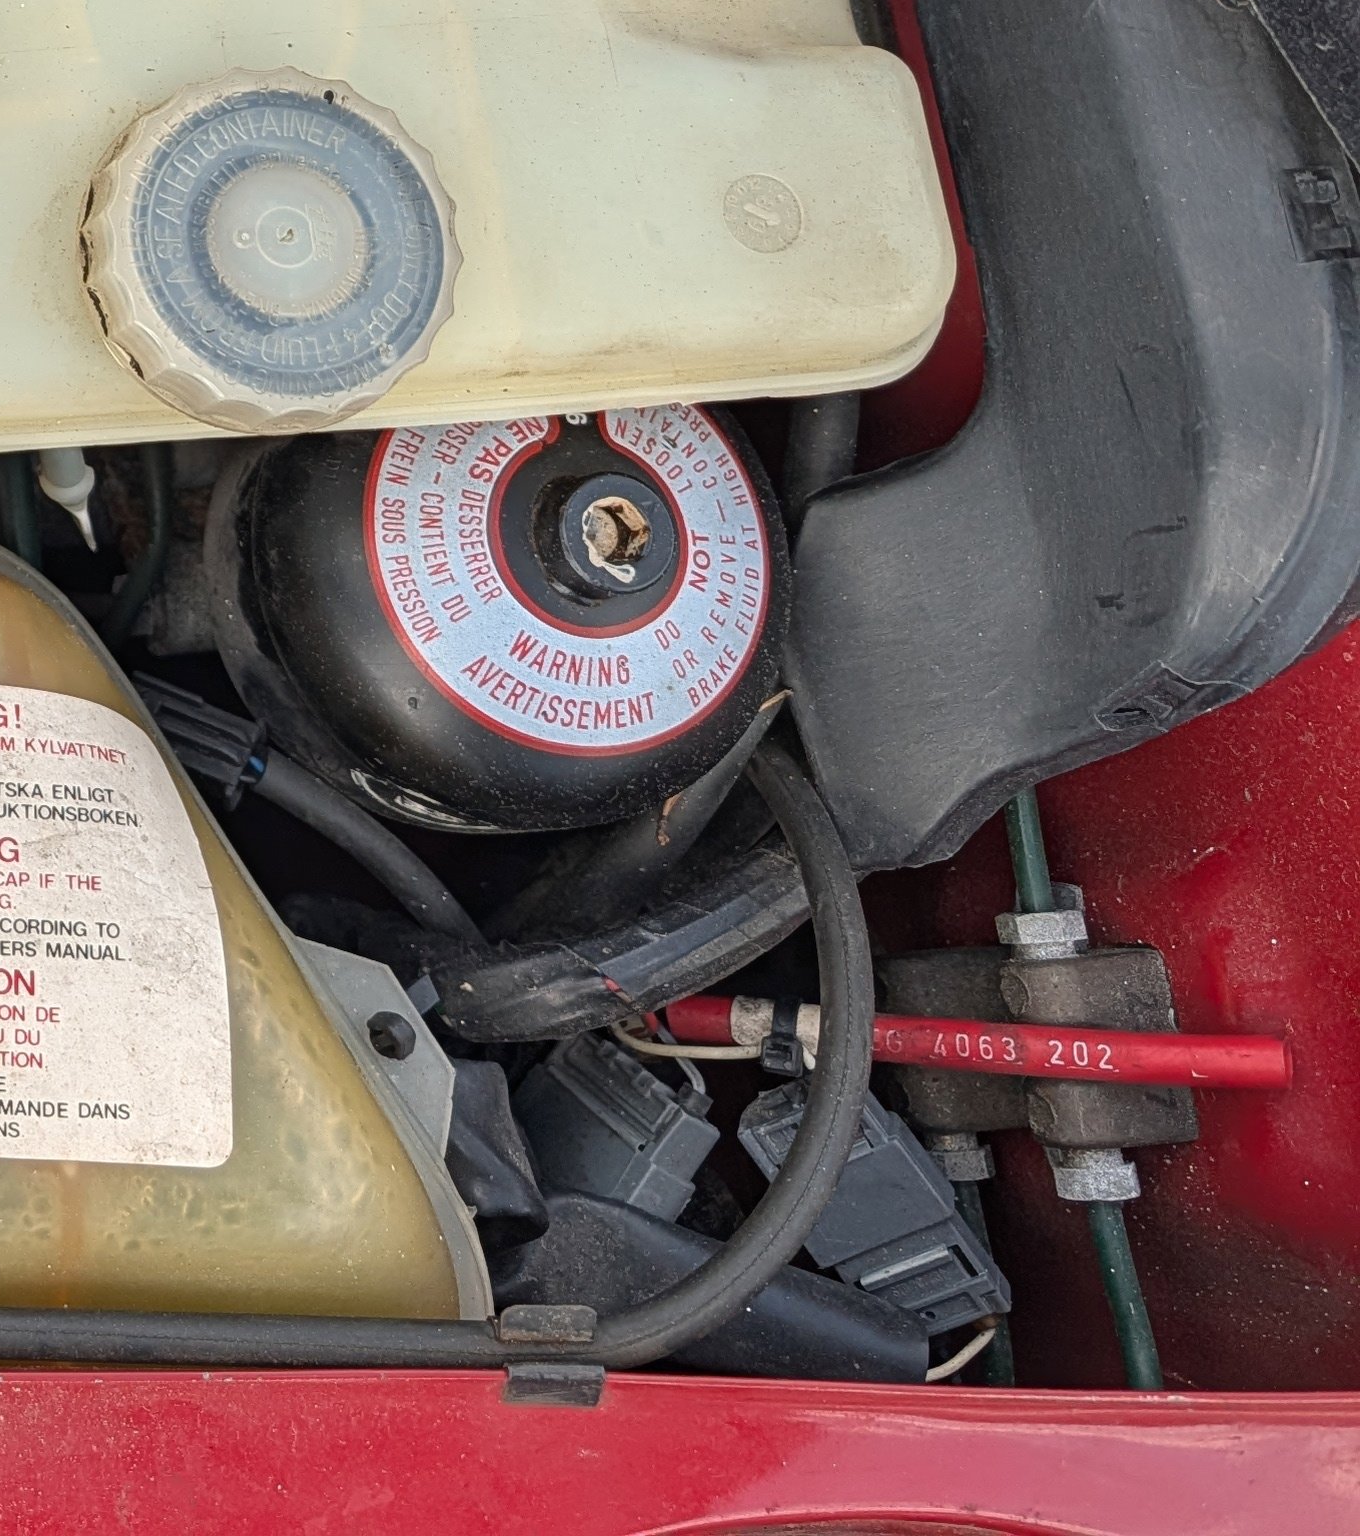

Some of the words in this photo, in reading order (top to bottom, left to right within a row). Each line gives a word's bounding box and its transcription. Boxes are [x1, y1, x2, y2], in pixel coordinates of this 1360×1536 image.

[194, 109, 347, 159] CONTAINER
[155, 154, 203, 260] SEALED
[261, 332, 340, 366] FLUID
[506, 417, 545, 443] NE
[385, 429, 426, 487] FREIN
[468, 436, 513, 484] PAS
[615, 417, 693, 494] LOOSEN
[714, 452, 749, 507] HIGH
[382, 497, 406, 545] SOUS
[740, 525, 759, 551] AT
[419, 492, 457, 587] CONTIENT
[441, 593, 472, 623] DU
[459, 489, 503, 605] DESSERRER
[688, 529, 711, 592] NOT
[385, 554, 442, 645] PRESSION
[672, 648, 700, 679] OR
[700, 535, 737, 645] REMOVE
[735, 567, 760, 636] FLUID
[508, 629, 630, 688] WARNING
[654, 618, 681, 651] DO
[459, 655, 658, 730] AVERTISSEMENT
[687, 643, 739, 708] BRAKE
[24, 738, 128, 764] KYLVATTNET
[52, 783, 115, 803] ENLIGT
[39, 873, 54, 889] IF
[65, 874, 102, 891] THE
[45, 942, 133, 962] MANUAL.
[96, 921, 120, 938] TO
[14, 1028, 41, 1045] DU
[36, 1006, 61, 1023] DE
[934, 1031, 1018, 1062] 4063
[1047, 1039, 1115, 1070] 202
[77, 1102, 131, 1119] DANS
